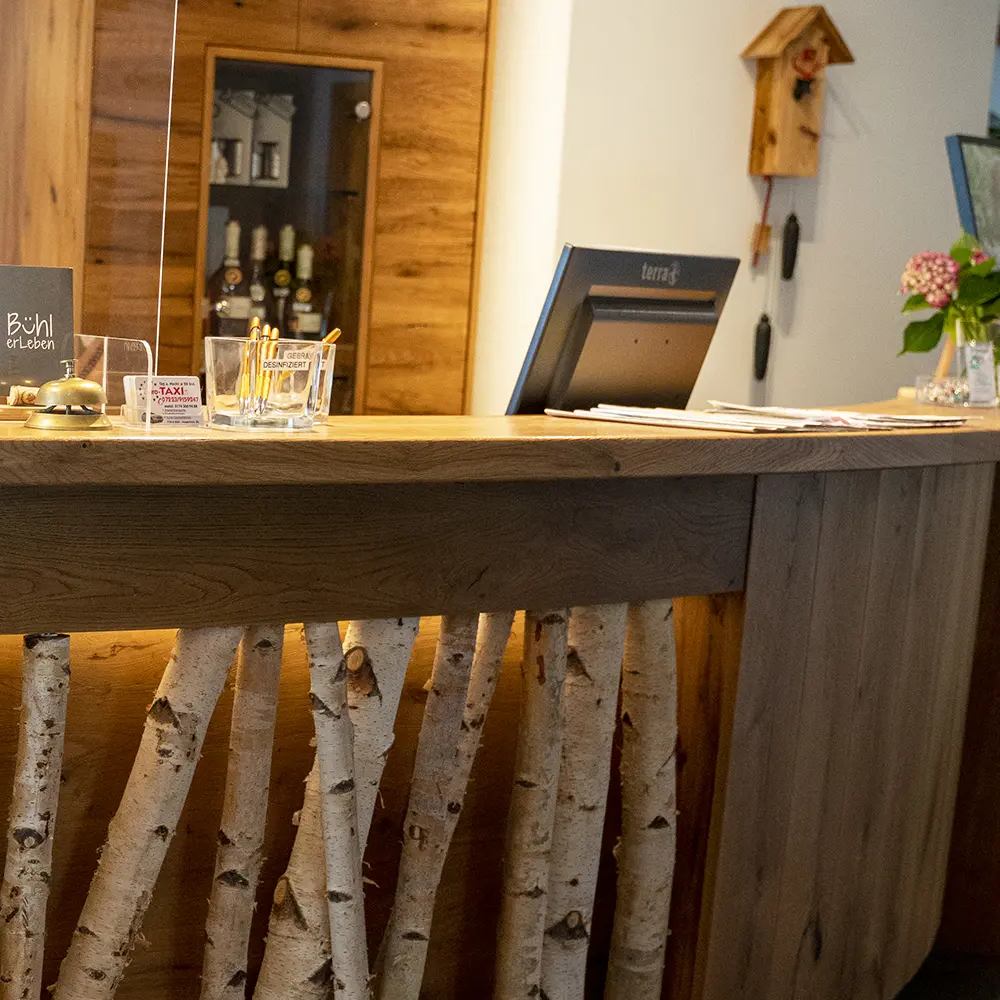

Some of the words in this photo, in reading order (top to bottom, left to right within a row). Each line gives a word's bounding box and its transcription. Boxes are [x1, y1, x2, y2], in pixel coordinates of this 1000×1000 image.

[641, 262, 669, 281] terra
[7, 312, 53, 338] Bühl
[263, 361, 307, 369] DESINFIZIERT
